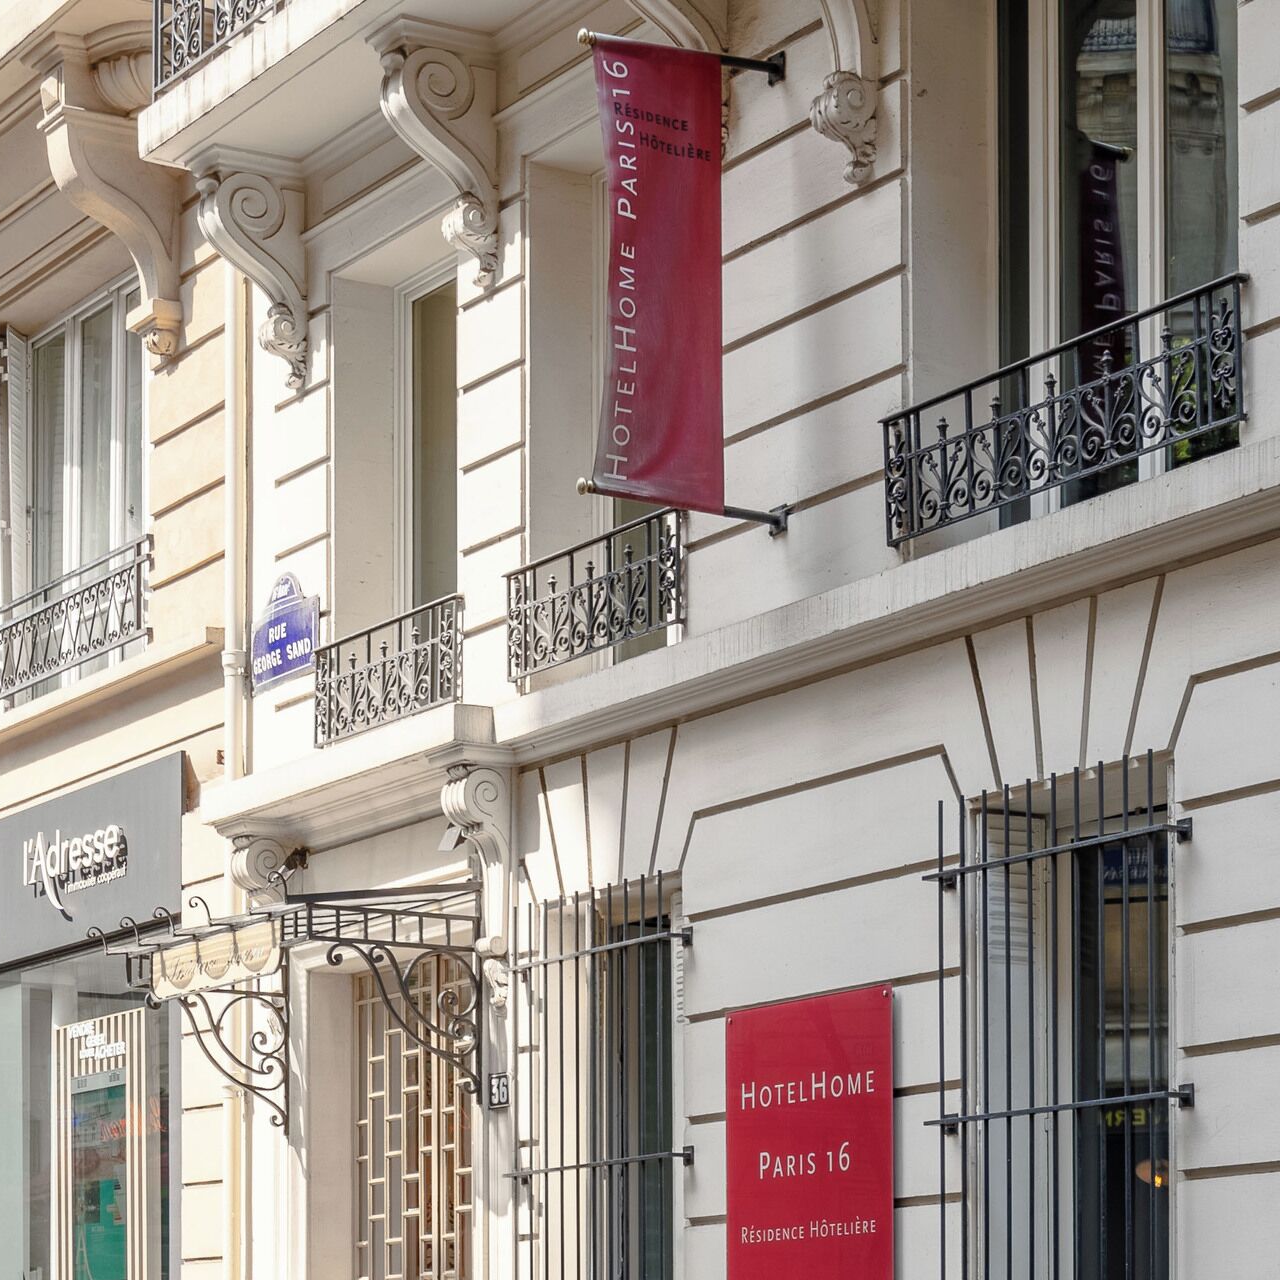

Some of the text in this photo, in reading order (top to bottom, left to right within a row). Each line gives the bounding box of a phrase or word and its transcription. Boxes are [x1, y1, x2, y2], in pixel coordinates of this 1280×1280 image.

[603, 60, 631, 98] 16
[613, 101, 689, 132] RÉSIDENCE
[639, 131, 712, 162] HÔTELIÈRE
[268, 622, 287, 644] RUE
[253, 637, 312, 675] GEORGE SAND
[491, 1077, 508, 1104] 36
[826, 1141, 851, 1172] 16
